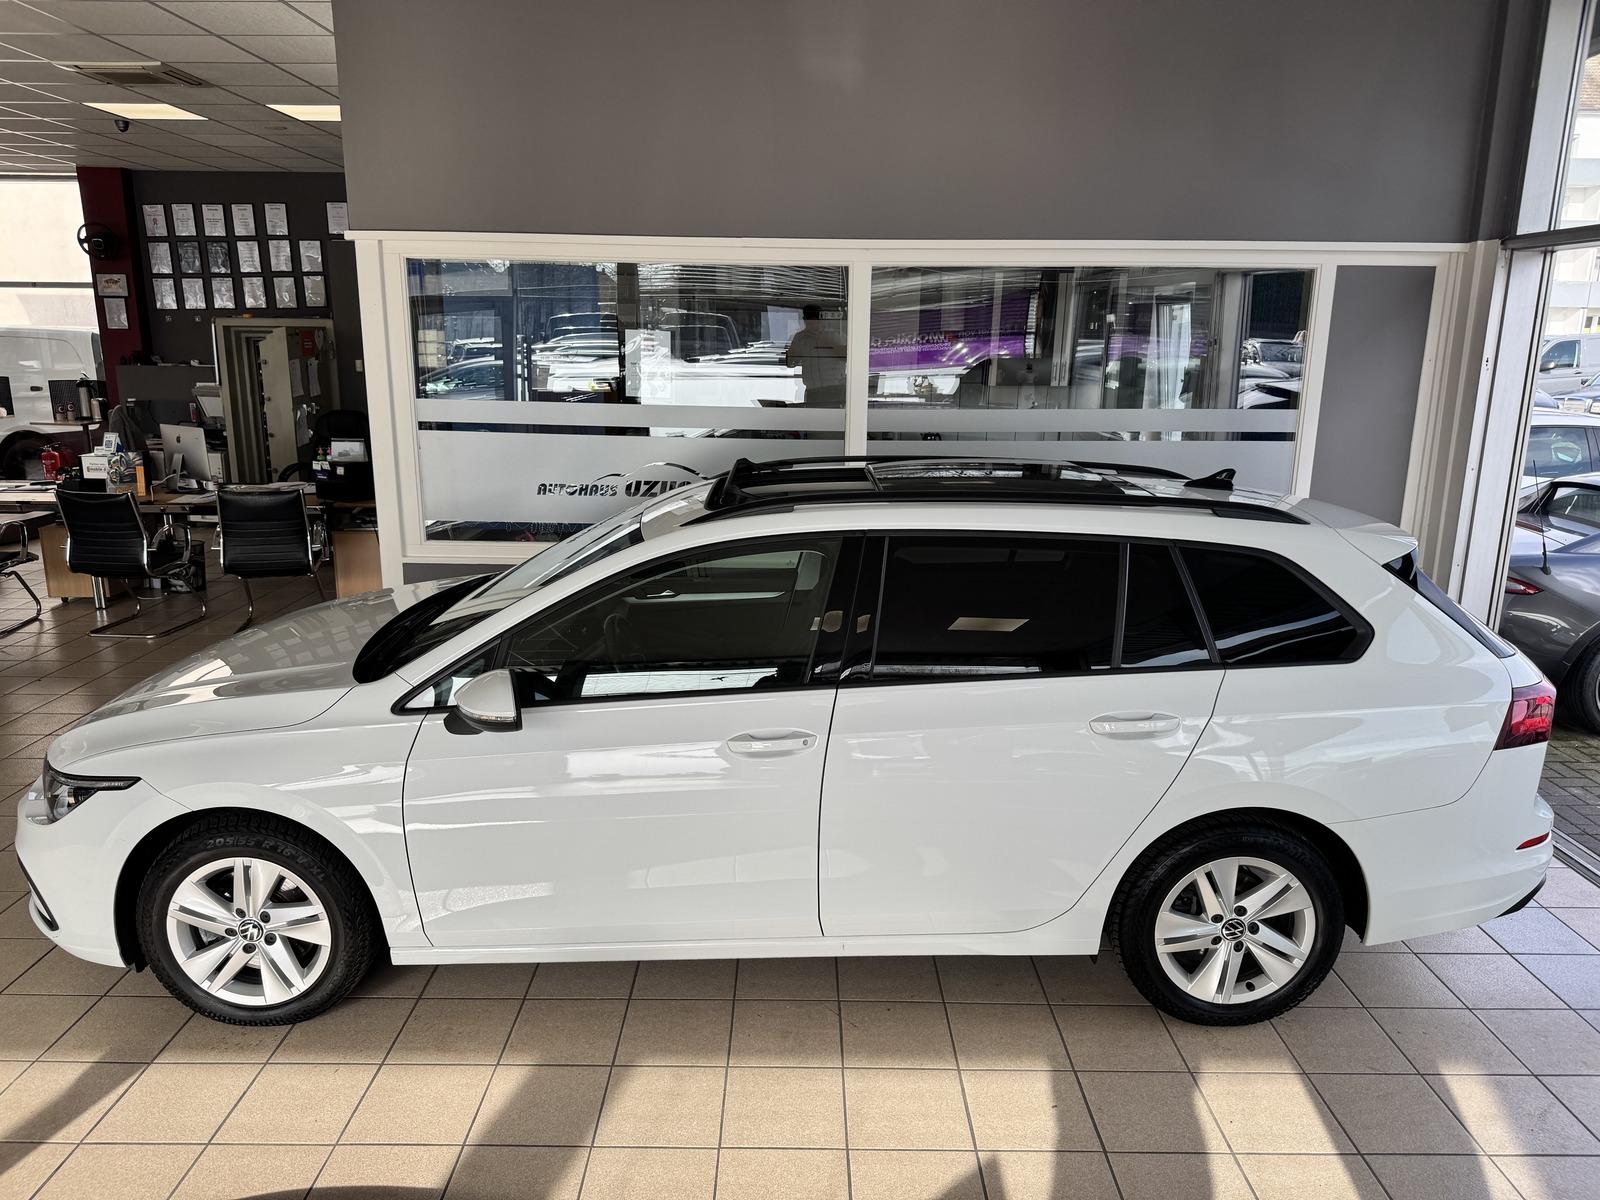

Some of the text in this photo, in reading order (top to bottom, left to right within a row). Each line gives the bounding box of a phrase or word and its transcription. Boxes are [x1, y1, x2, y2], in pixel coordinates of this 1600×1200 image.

[536, 480, 692, 497] AUTOHAUS UZU
[206, 836, 256, 849] 205/55
[262, 839, 276, 849] R
